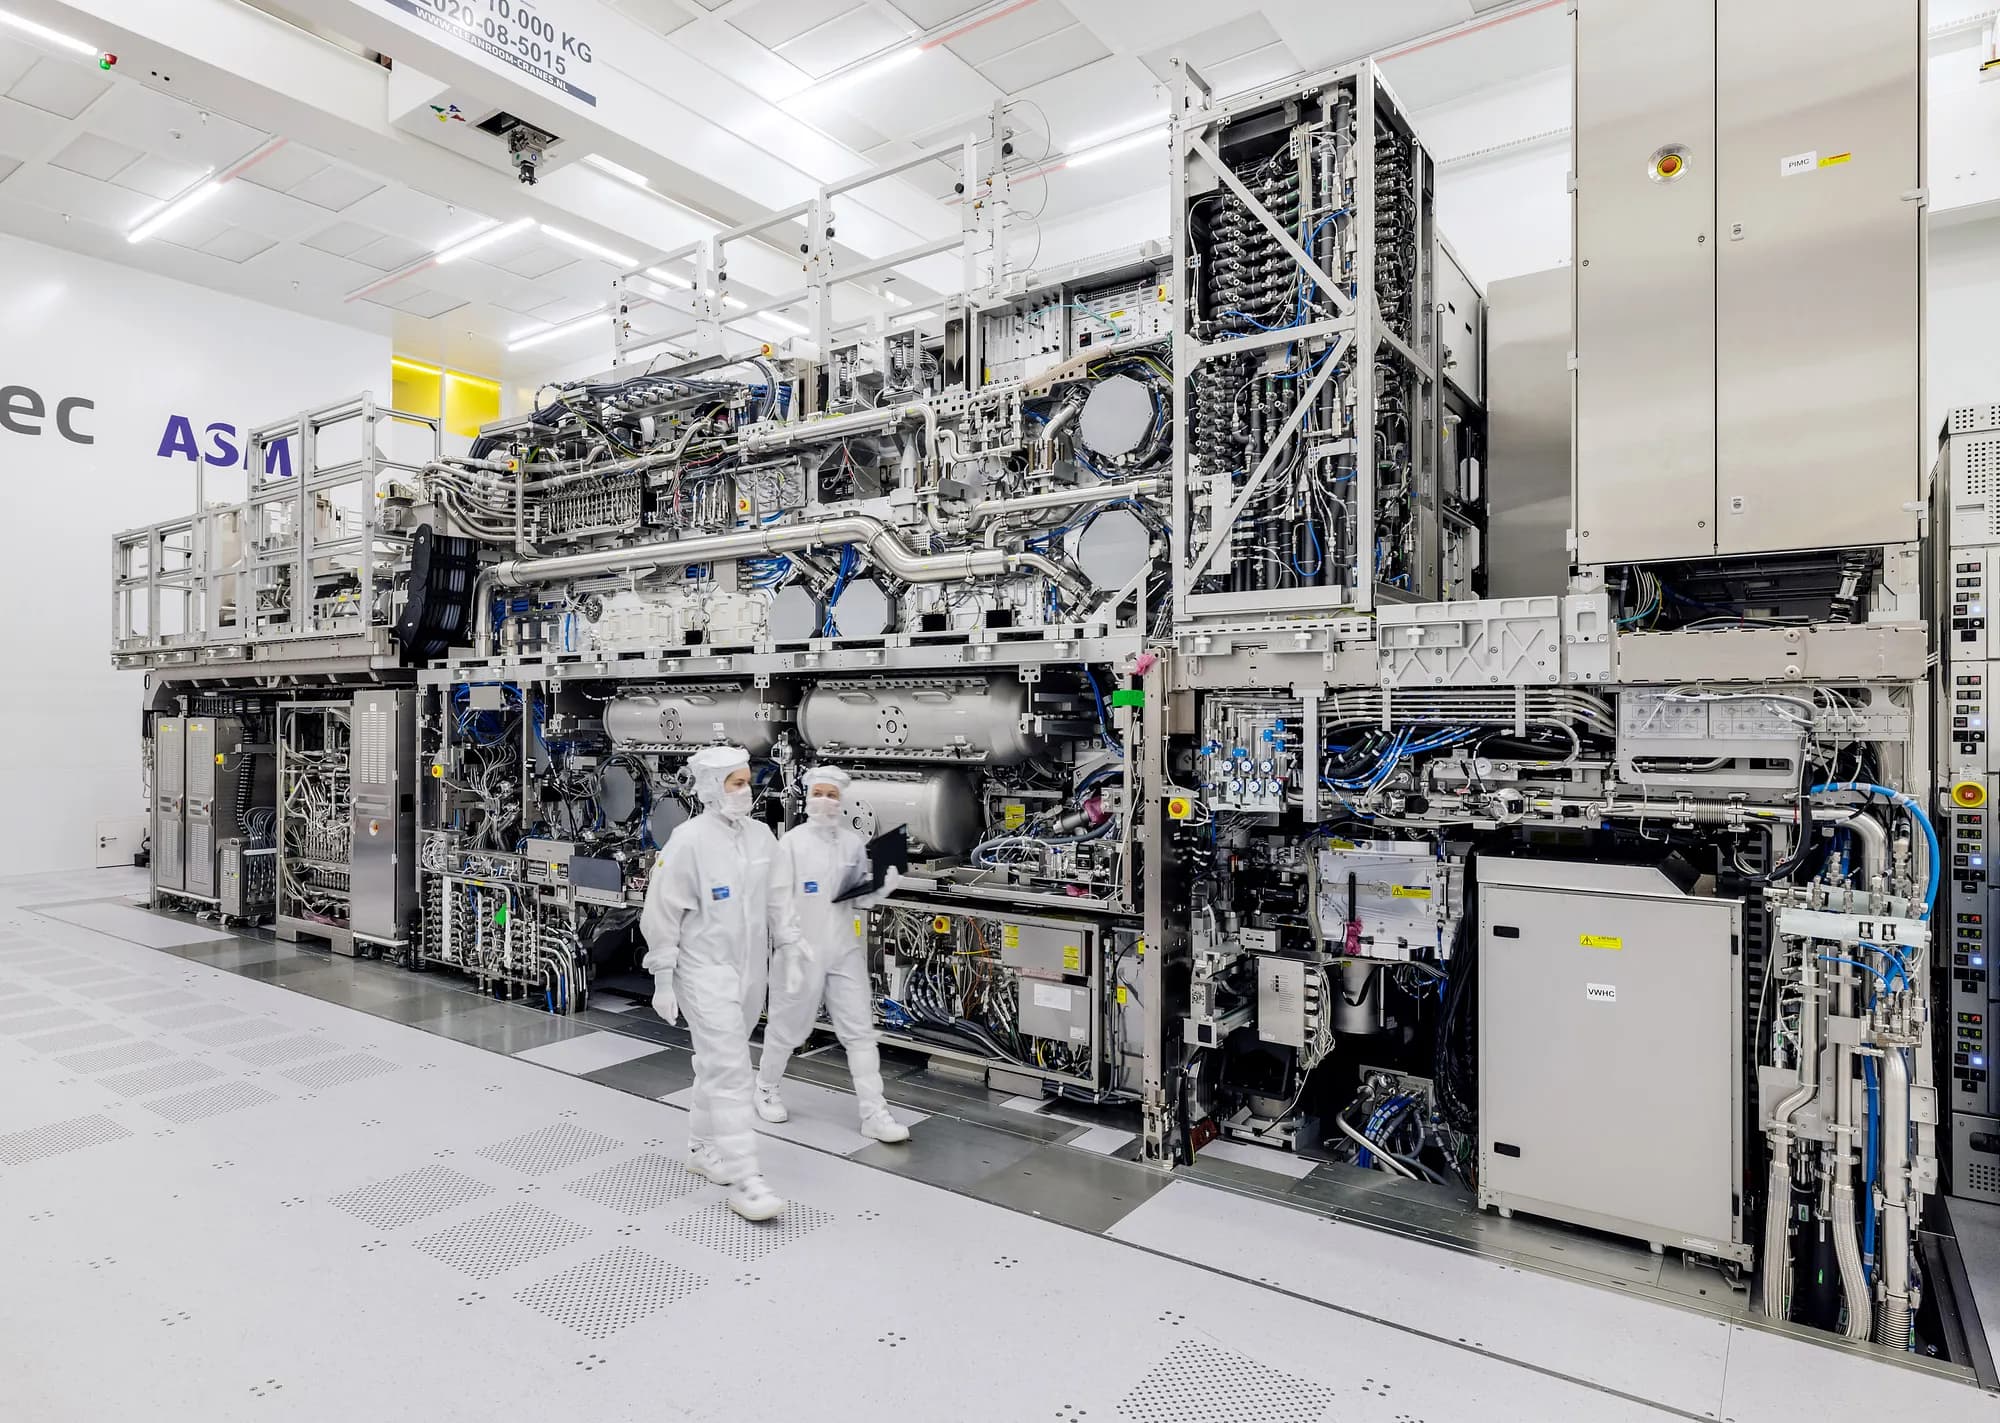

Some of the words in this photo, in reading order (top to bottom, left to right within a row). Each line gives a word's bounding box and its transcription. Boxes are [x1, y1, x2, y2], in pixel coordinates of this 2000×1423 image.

[415, 6, 569, 92] WWW.CLEANROOM-CRANES.NL
[562, 32, 593, 63] KG
[1587, 988, 1615, 998] VWHC
